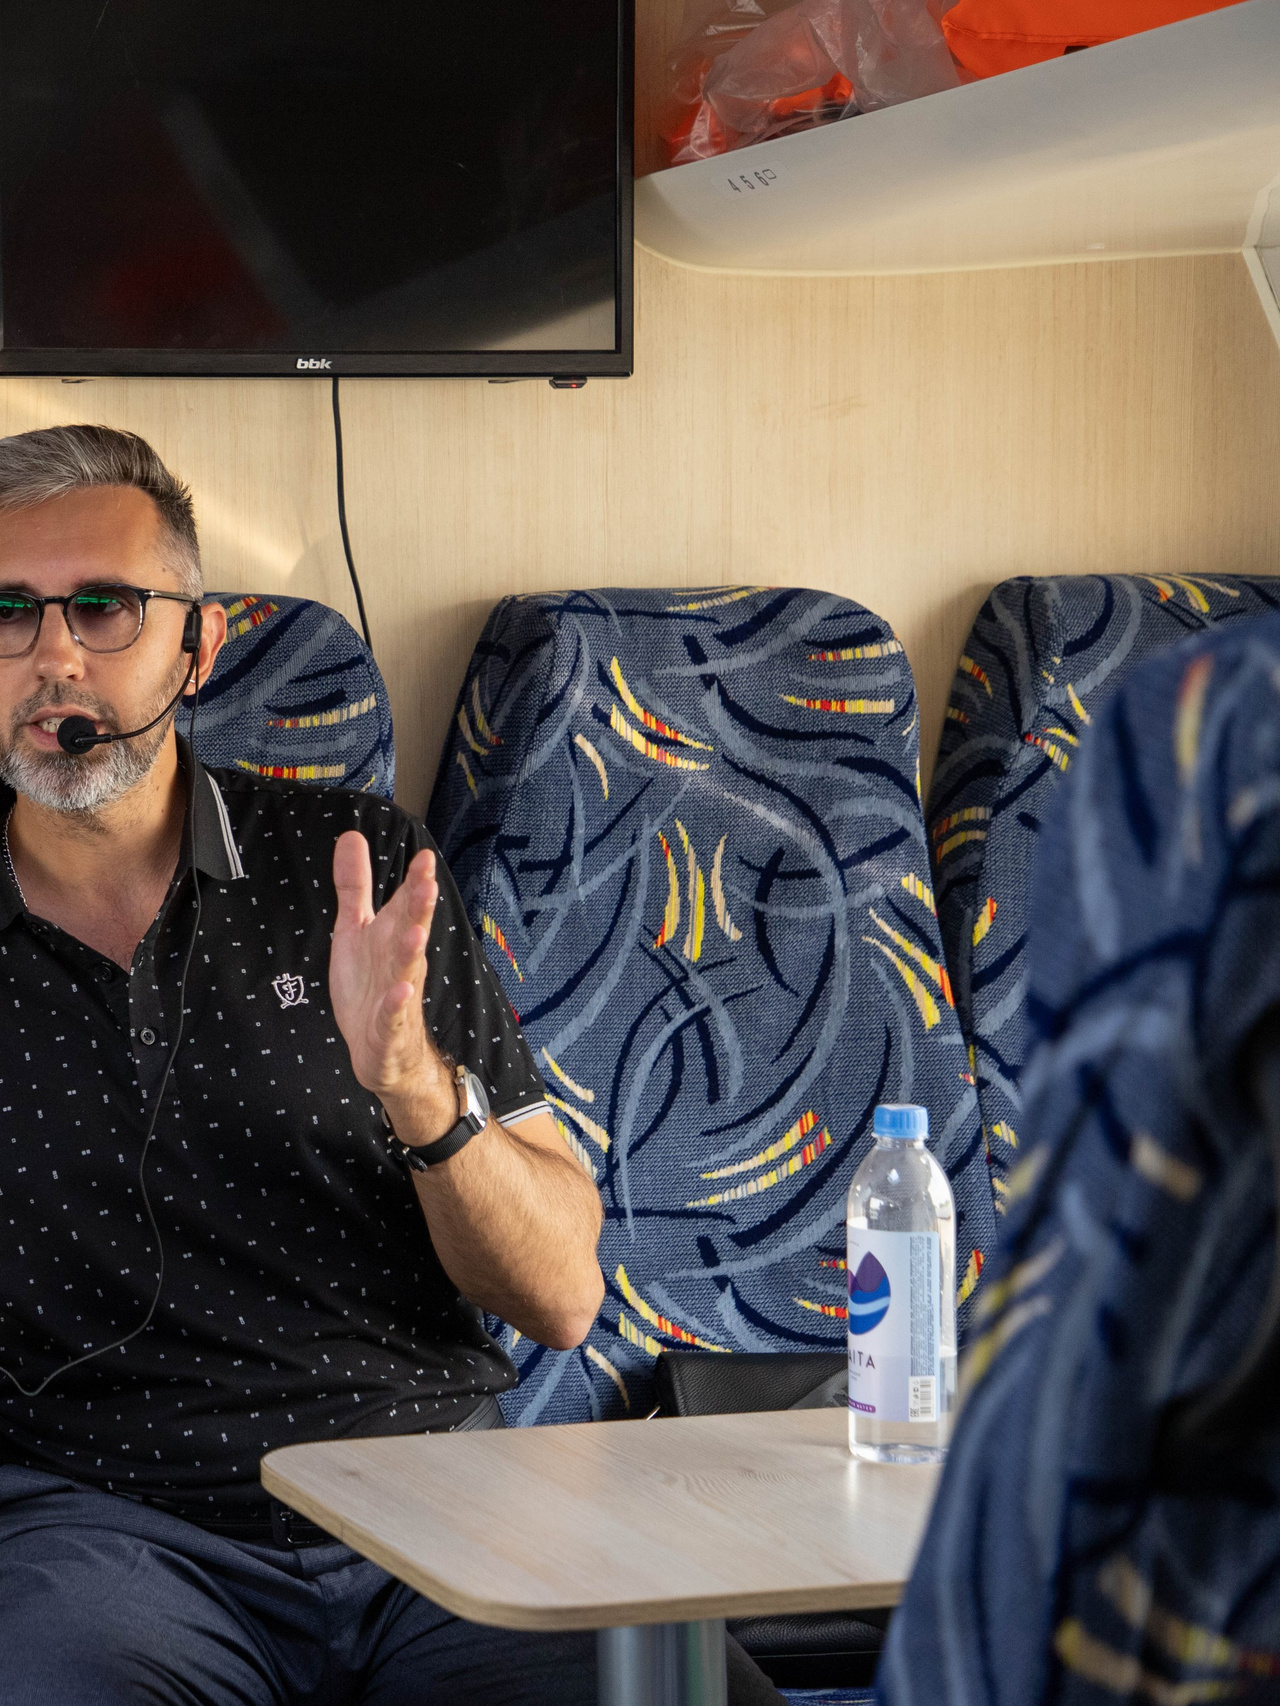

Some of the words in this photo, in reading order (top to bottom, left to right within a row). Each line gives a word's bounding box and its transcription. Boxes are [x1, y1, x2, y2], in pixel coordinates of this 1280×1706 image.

[728, 179, 741, 192] 4
[740, 175, 754, 189] 5
[754, 172, 769, 186] 6
[296, 358, 333, 370] bbk
